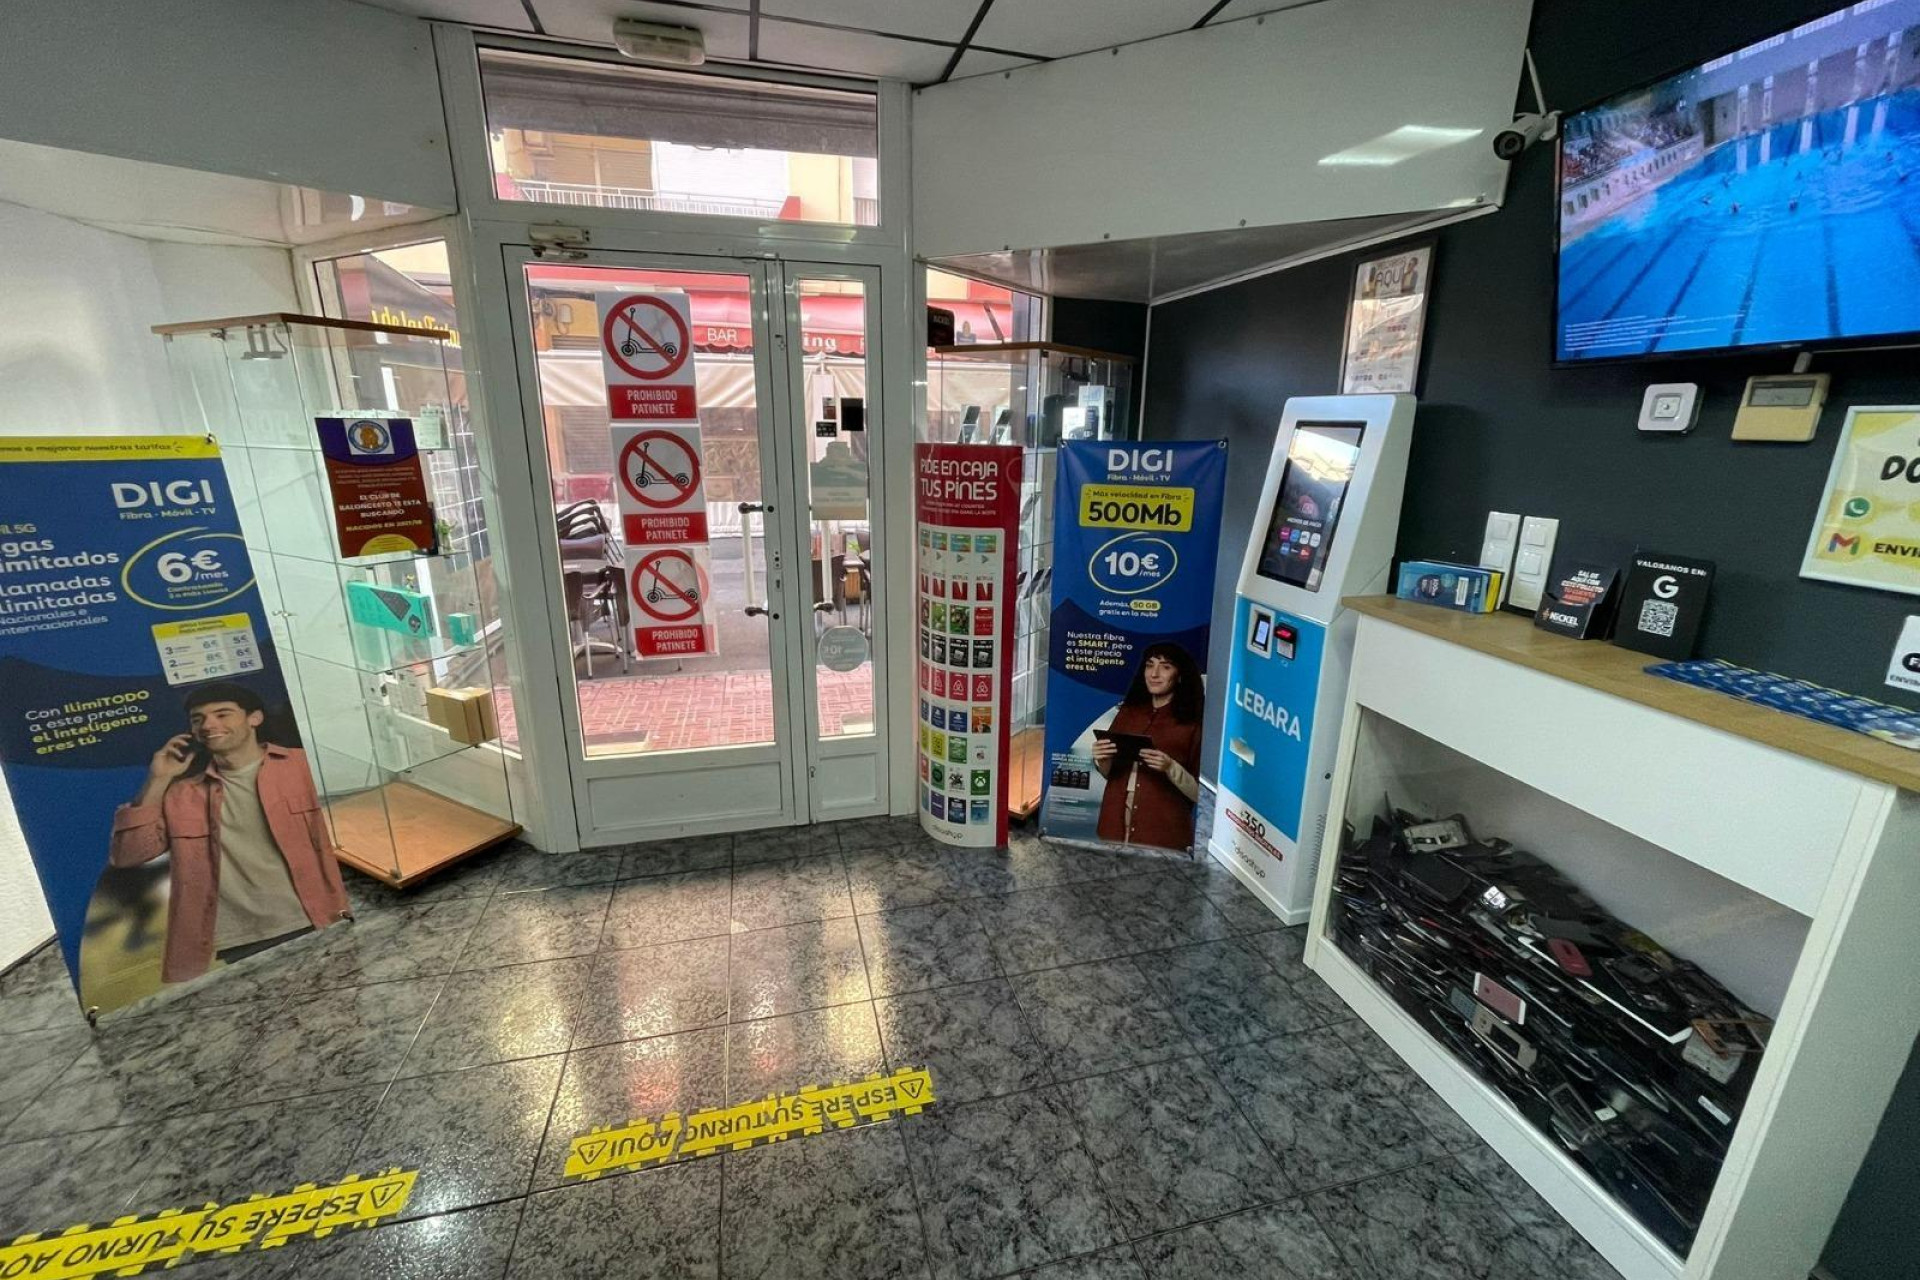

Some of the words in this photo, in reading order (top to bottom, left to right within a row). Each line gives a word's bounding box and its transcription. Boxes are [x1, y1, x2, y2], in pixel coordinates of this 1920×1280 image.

[707, 328, 738, 342] BAR
[627, 390, 678, 401] PROHIBIDO
[631, 403, 676, 414] PATINETE
[1108, 448, 1173, 472] DIGI
[960, 461, 998, 480] CAJA
[111, 479, 214, 509] DIGI
[920, 478, 942, 498] TUS
[119, 510, 152, 520] Fibra
[161, 508, 195, 518] Móvil
[202, 507, 216, 515] TV
[1088, 501, 1182, 526] 500Mb
[13, 523, 37, 534] 5G
[641, 517, 690, 529] PROHIBIDO
[645, 529, 689, 540] PATINETE
[157, 549, 223, 584] 6€
[1104, 551, 1159, 577] 10€
[1636, 559, 1690, 574] VALORANOS
[652, 628, 699, 640] PROHIBIDO
[1067, 631, 1102, 640] Nuestra
[1103, 632, 1125, 642] fibra
[655, 640, 697, 652] PATINETE
[1076, 655, 1125, 665] inteligente
[25, 707, 61, 720] Con
[1235, 682, 1302, 742] LEBARA
[29, 723, 42, 732] a
[46, 715, 84, 729] este
[33, 732, 52, 743] el
[54, 714, 149, 740] inteligente
[36, 740, 76, 755] eres
[78, 734, 102, 746] tú.
[812, 1086, 897, 1116] ESPERE
[773, 1100, 804, 1124] SU
[242, 1191, 364, 1233] ESPERE
[189, 1216, 238, 1243] SU
